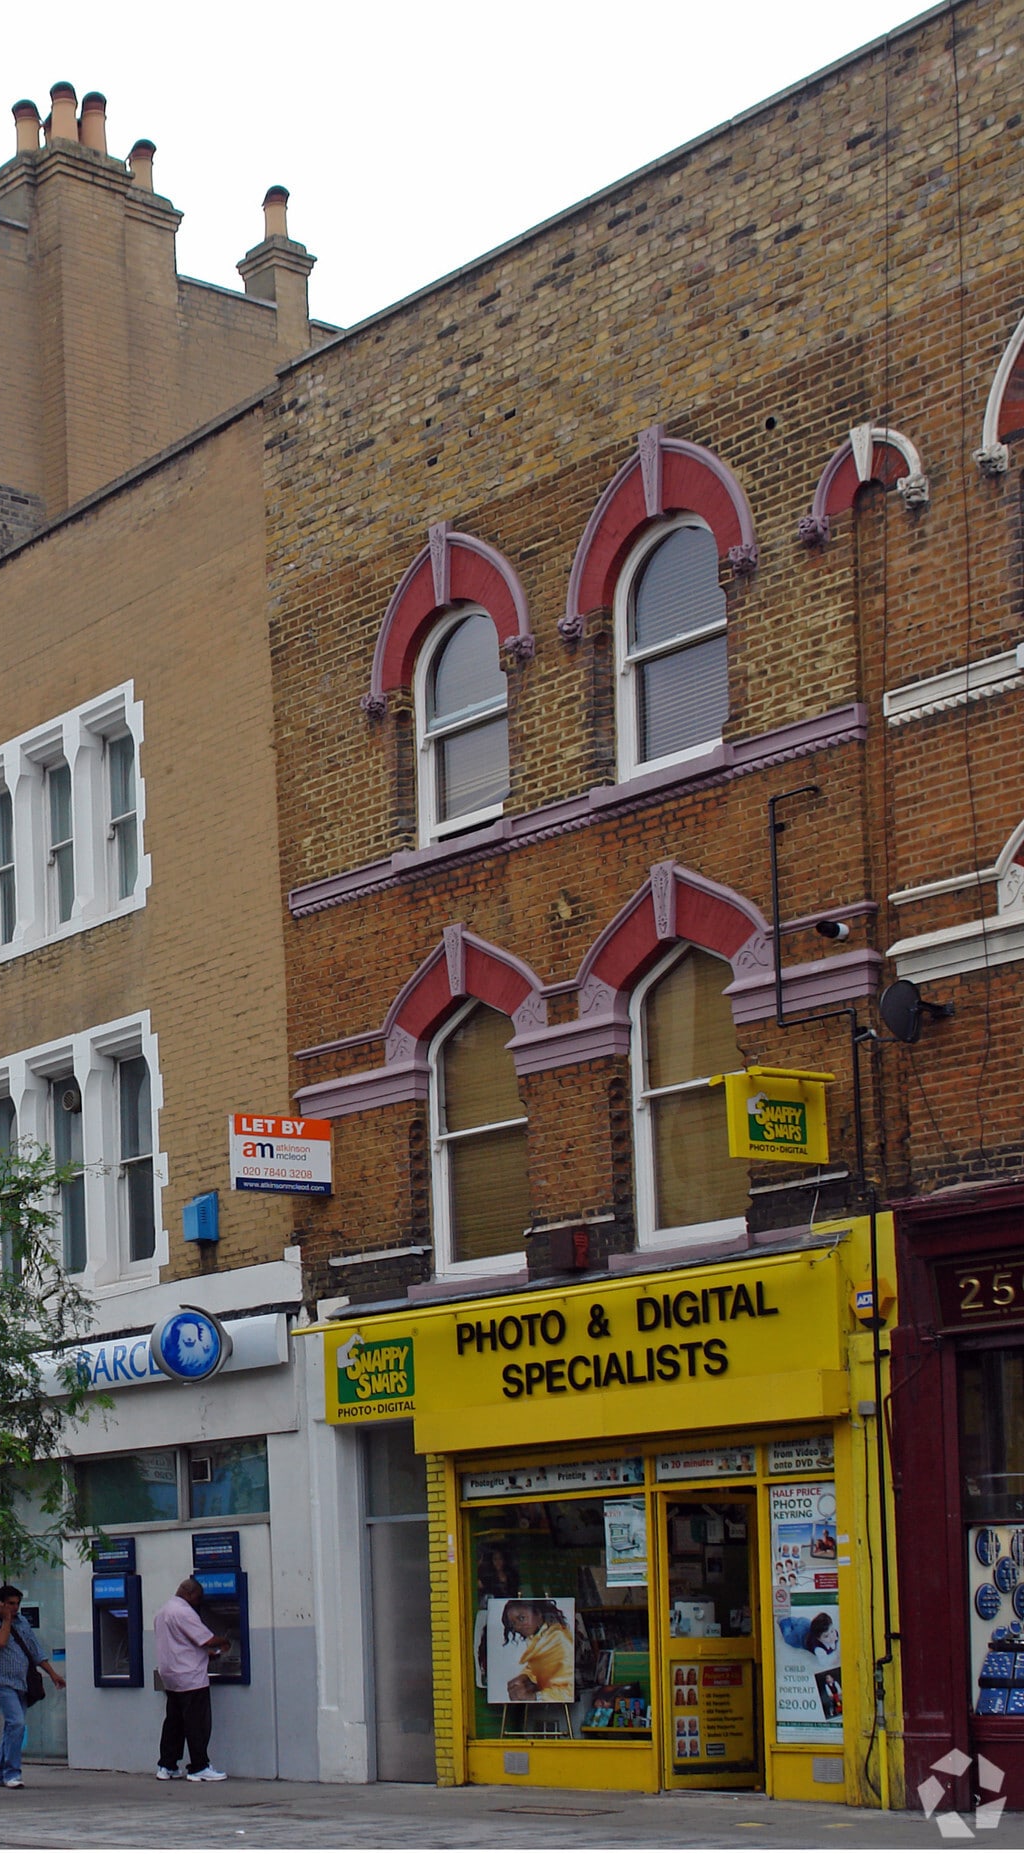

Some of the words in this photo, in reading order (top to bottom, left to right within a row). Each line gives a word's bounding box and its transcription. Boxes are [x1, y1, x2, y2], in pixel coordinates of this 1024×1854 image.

[754, 1101, 802, 1125] SNAPPY
[241, 1117, 276, 1134] LET
[281, 1120, 306, 1136] BY
[762, 1122, 802, 1142] SNAPS
[242, 1141, 275, 1159] am
[276, 1143, 311, 1153] atkinson
[749, 1144, 776, 1152] PHOTO
[779, 1145, 808, 1155] DIGITAL
[276, 1152, 307, 1161] mcleod
[242, 1166, 261, 1176] 020
[263, 1167, 287, 1178] 7840
[289, 1169, 313, 1179] 3208
[959, 1271, 1024, 1309] 25
[456, 1310, 567, 1355] PHOTO
[587, 1303, 611, 1339] &
[636, 1281, 779, 1332] DIGITAL
[76, 1341, 164, 1386] BARCL
[346, 1345, 409, 1380] SNAPPY
[502, 1338, 729, 1399] SPECIALISTS
[356, 1371, 407, 1399] SNAPS
[337, 1405, 372, 1418] PHOTO
[377, 1401, 416, 1414] DIGITAL
[774, 1450, 793, 1458] from
[795, 1447, 819, 1457] Video
[683, 1458, 714, 1469] minutes
[774, 1461, 793, 1469] onto
[795, 1458, 814, 1468] DVD
[558, 1470, 587, 1481] Printing
[773, 1488, 794, 1498] HALF
[796, 1487, 822, 1496] PRICE
[773, 1498, 812, 1509] PHOTO
[773, 1509, 813, 1519] KEYRING
[784, 1665, 806, 1673] CHILD
[779, 1686, 815, 1694] PORTRAIT
[778, 1699, 817, 1710] £20.00
